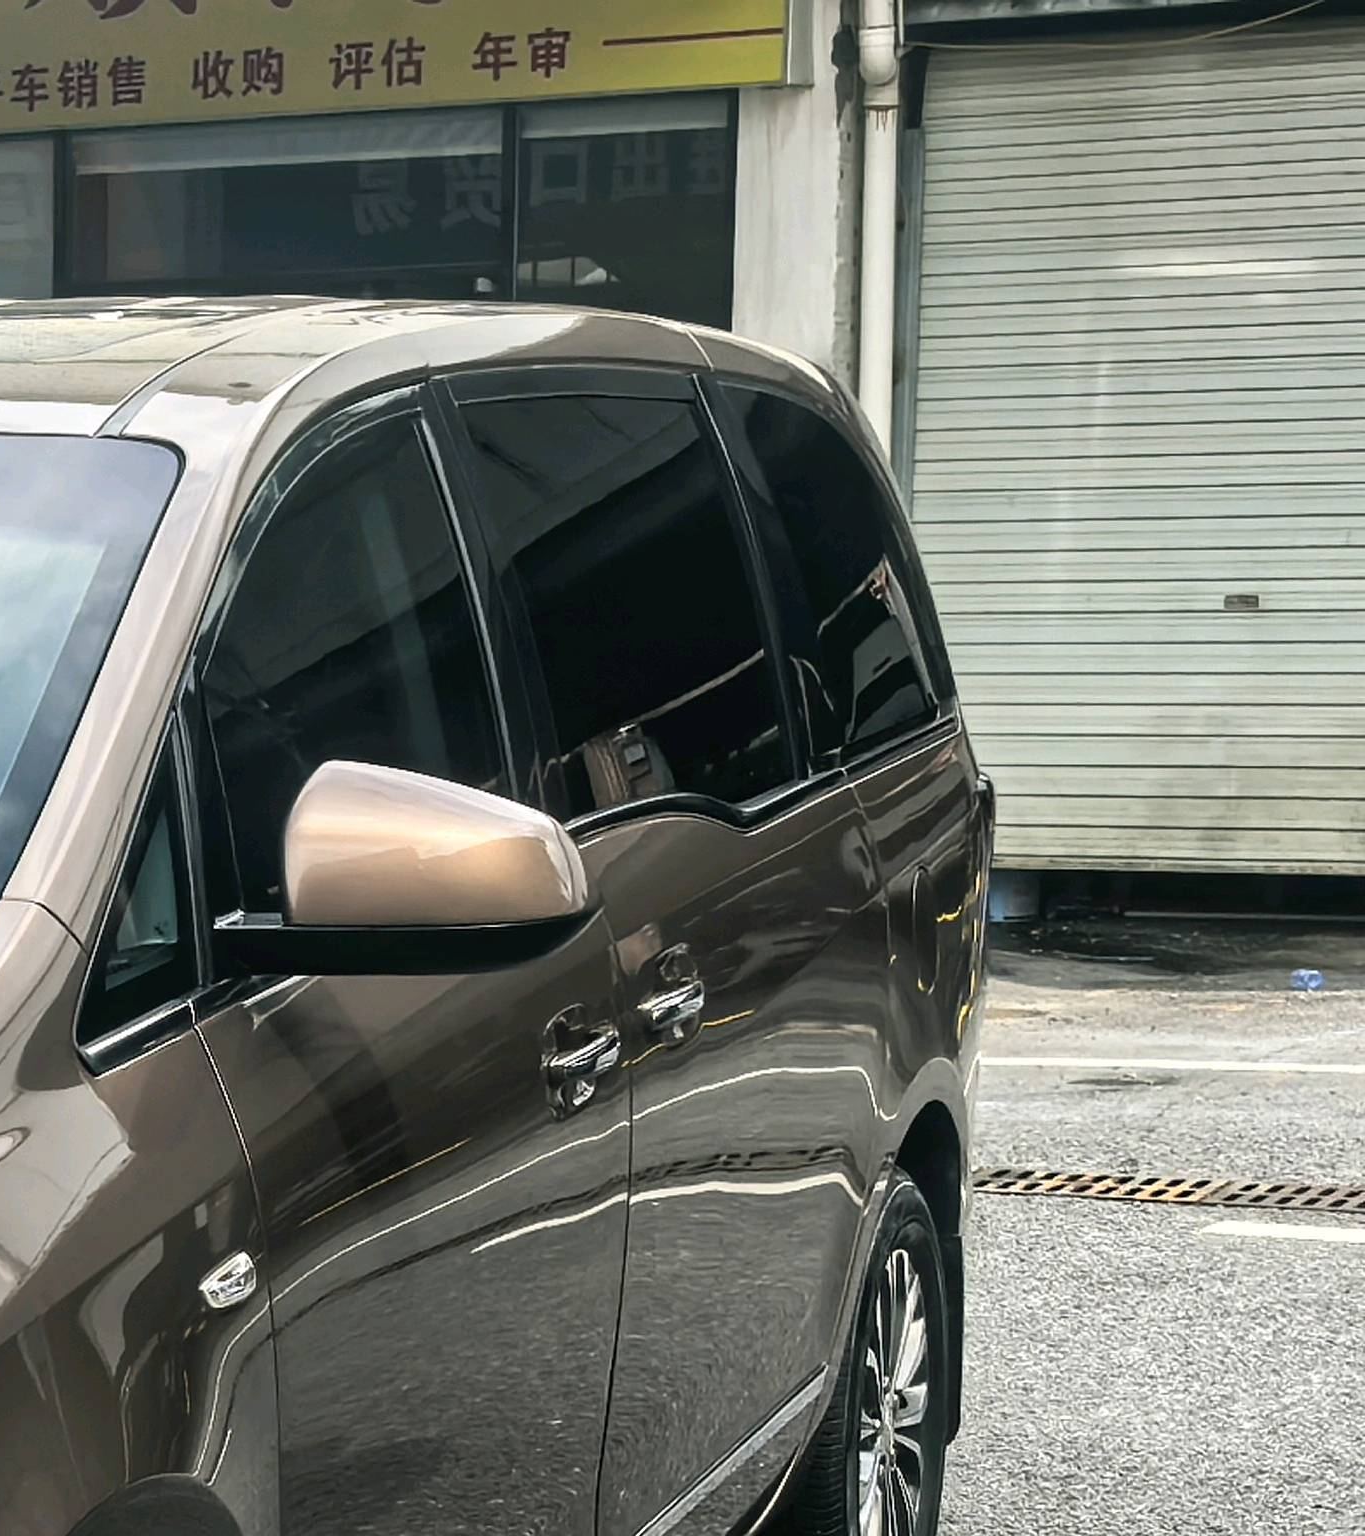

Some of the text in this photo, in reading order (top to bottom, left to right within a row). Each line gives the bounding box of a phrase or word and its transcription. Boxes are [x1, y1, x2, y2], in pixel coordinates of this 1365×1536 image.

[190, 48, 285, 97] 收购
[328, 38, 426, 92] 评估
[472, 28, 573, 82] 年审
